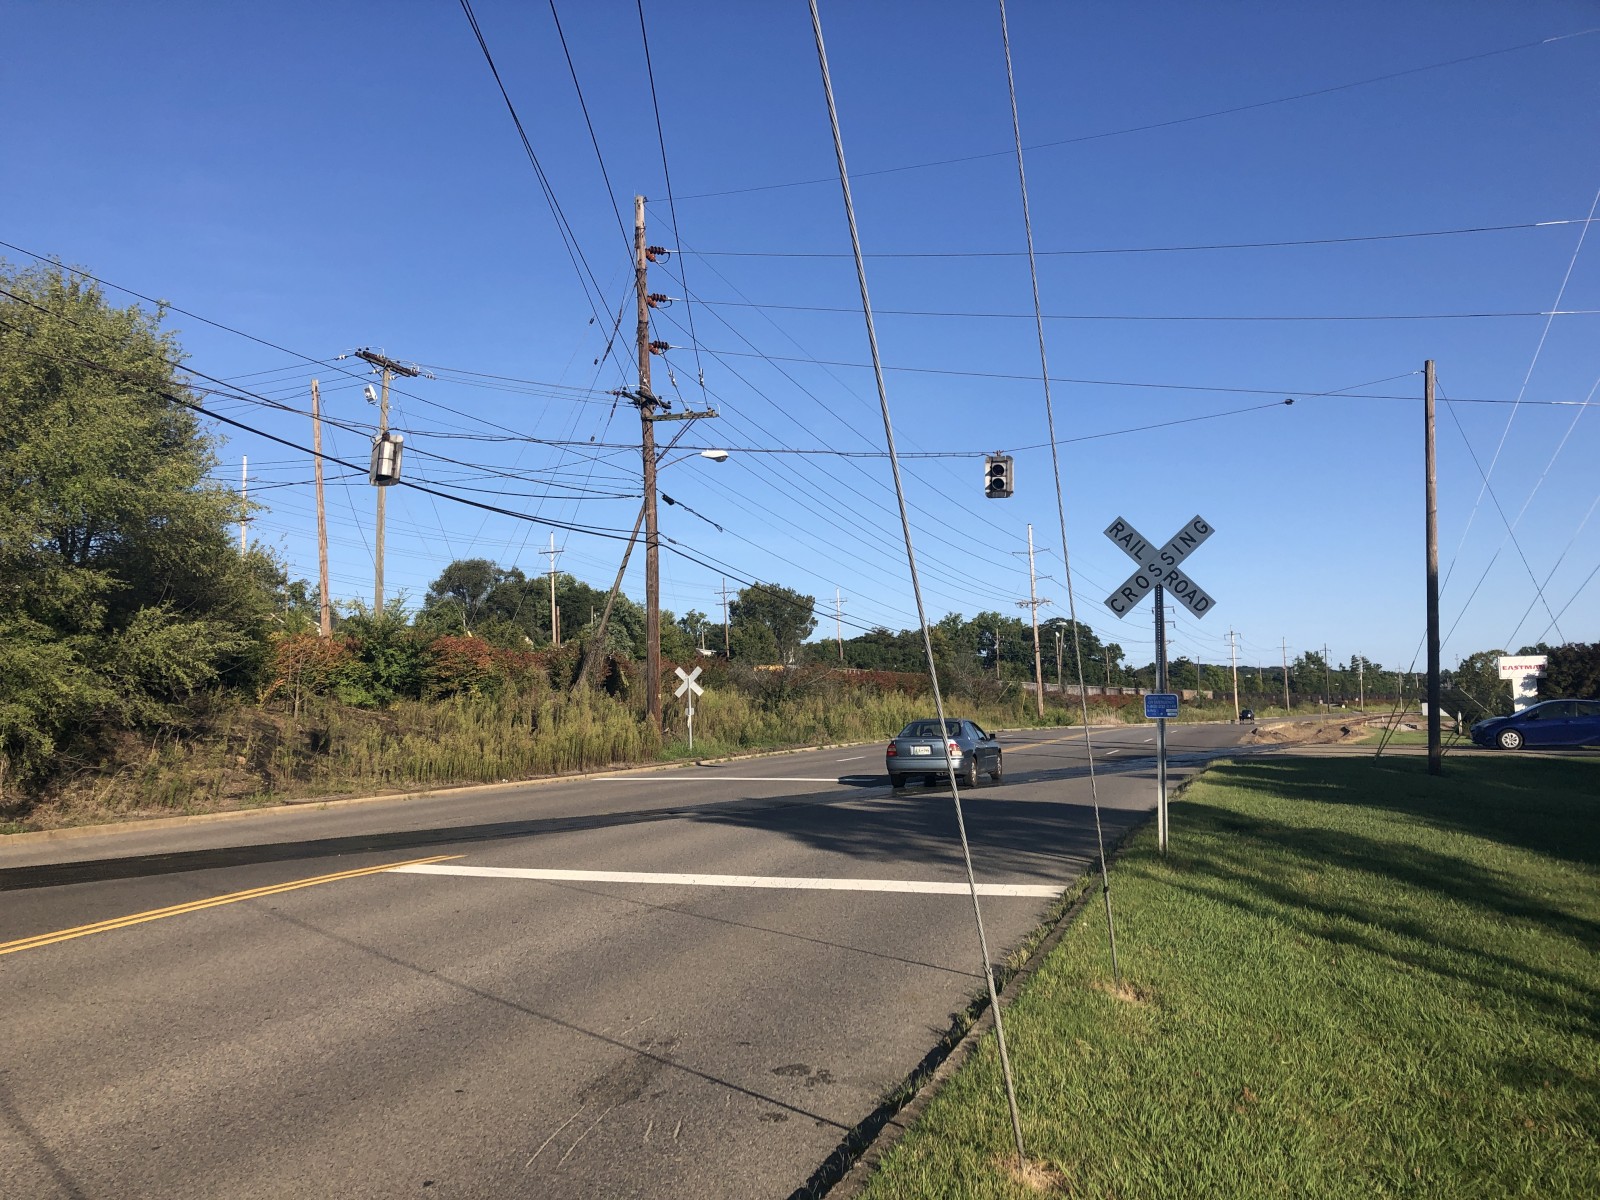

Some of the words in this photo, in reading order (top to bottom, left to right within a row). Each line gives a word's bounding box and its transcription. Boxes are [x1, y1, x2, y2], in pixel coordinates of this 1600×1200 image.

[1108, 520, 1147, 561] RAIL
[1162, 569, 1209, 612] ROAD
[1110, 520, 1209, 613] CROSSING
